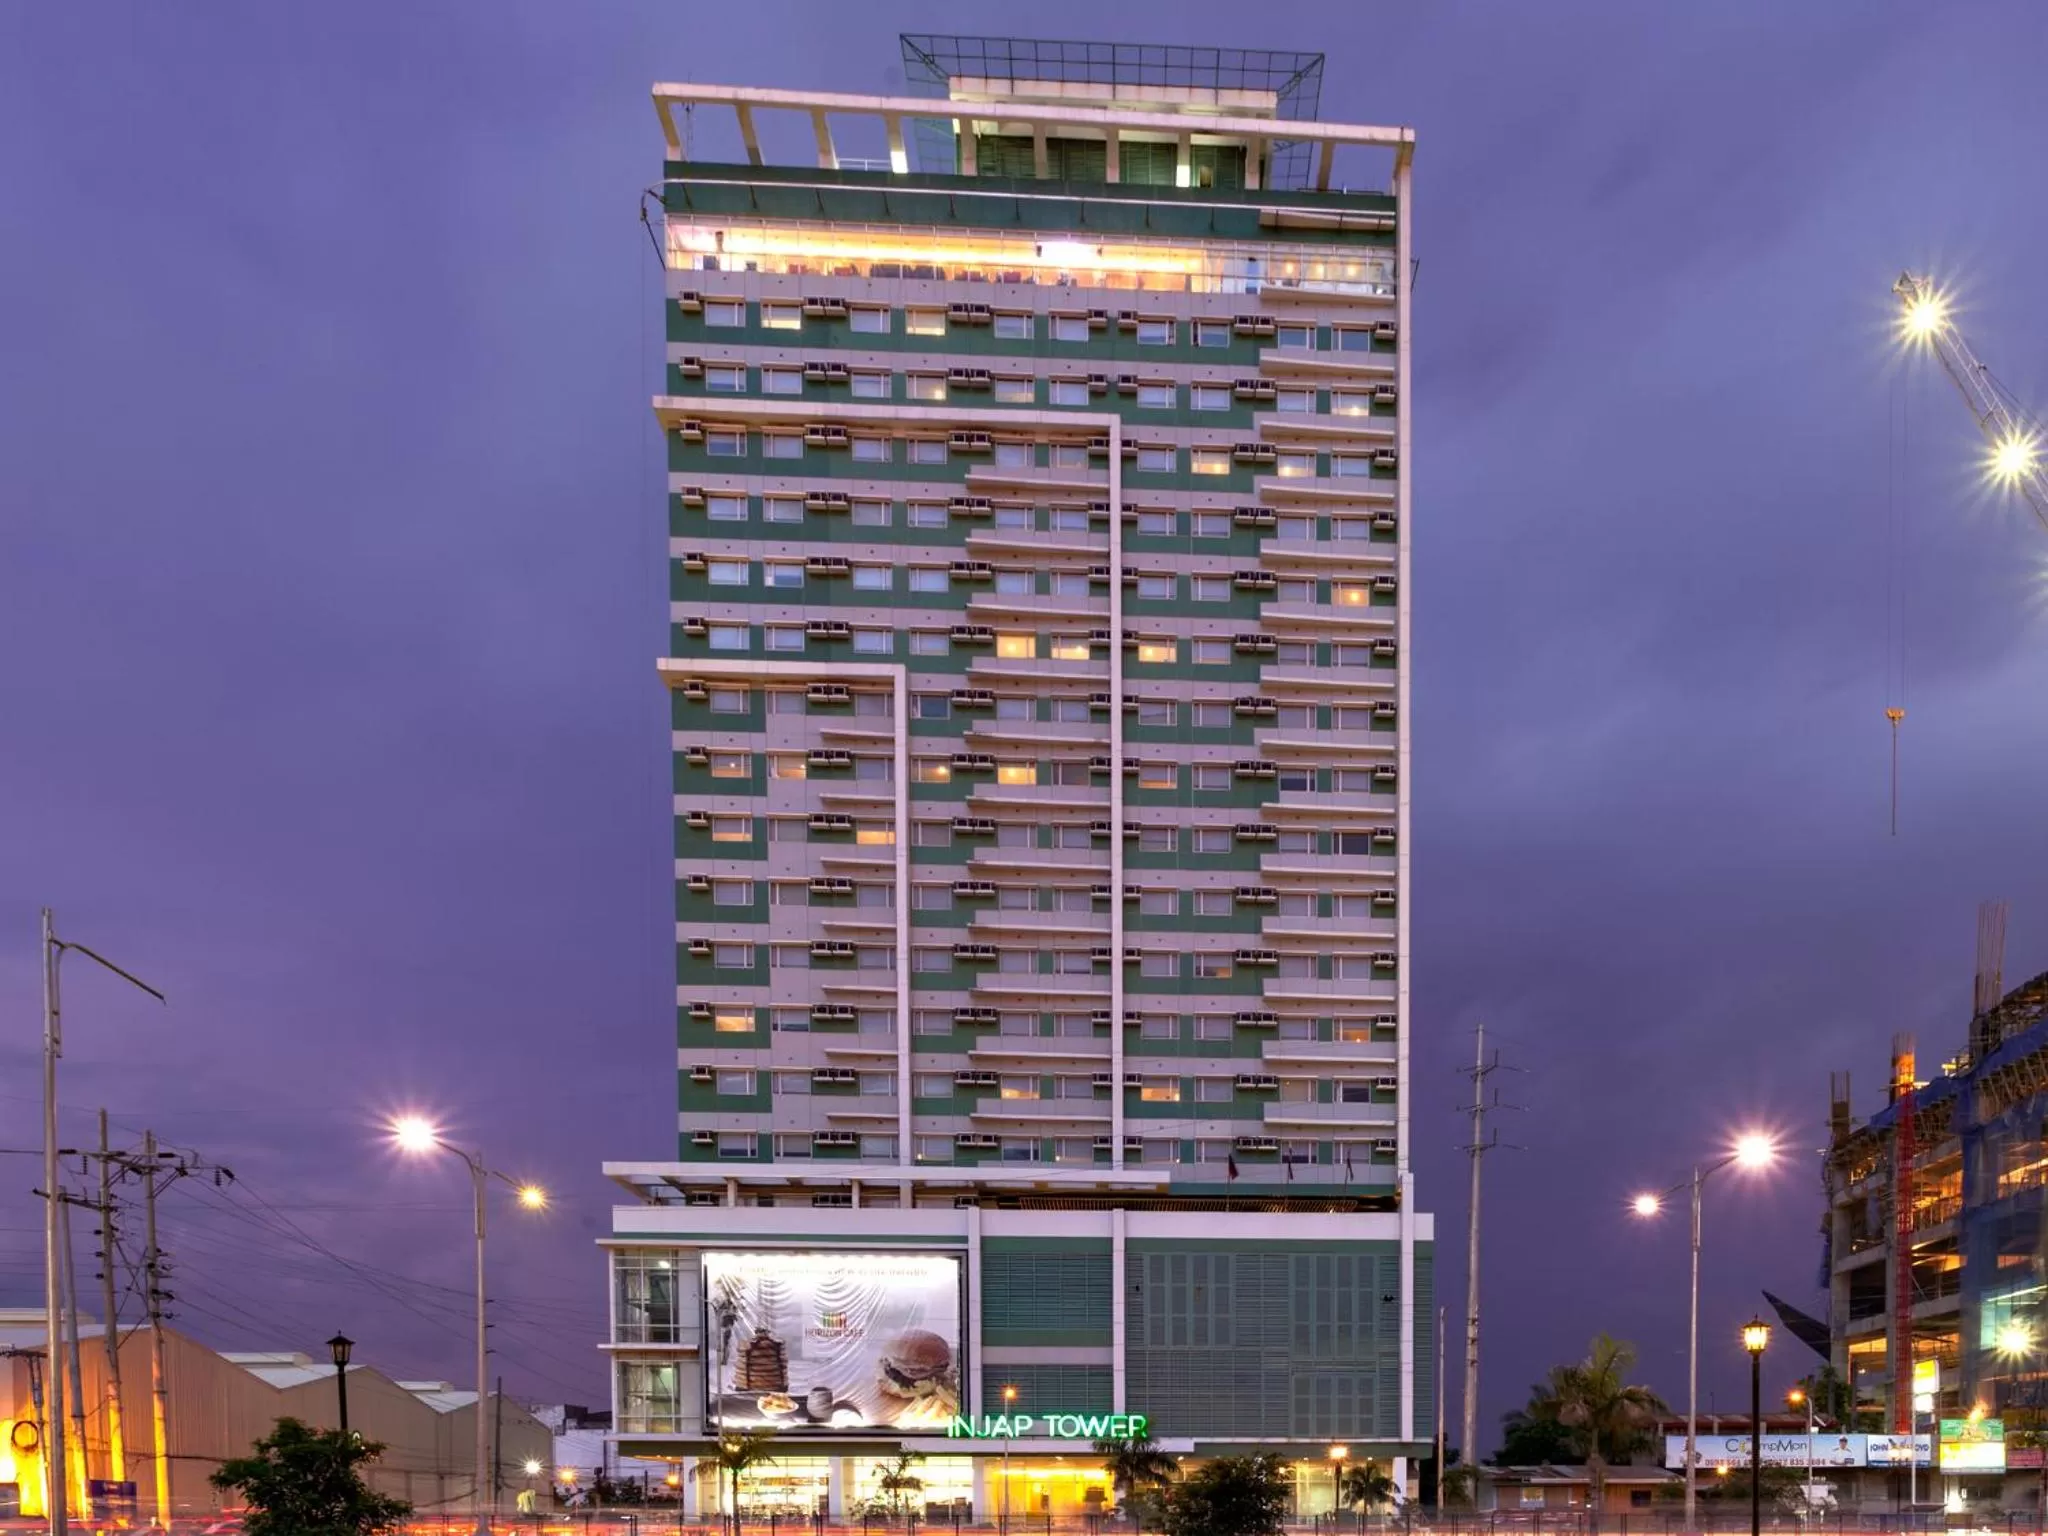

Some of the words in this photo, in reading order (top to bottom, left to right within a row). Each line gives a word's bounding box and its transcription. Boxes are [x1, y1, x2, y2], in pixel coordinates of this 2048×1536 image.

[805, 1327, 842, 1338] HORIZON
[948, 1415, 1033, 1438] INJAP
[1042, 1415, 1147, 1438] TOWER
